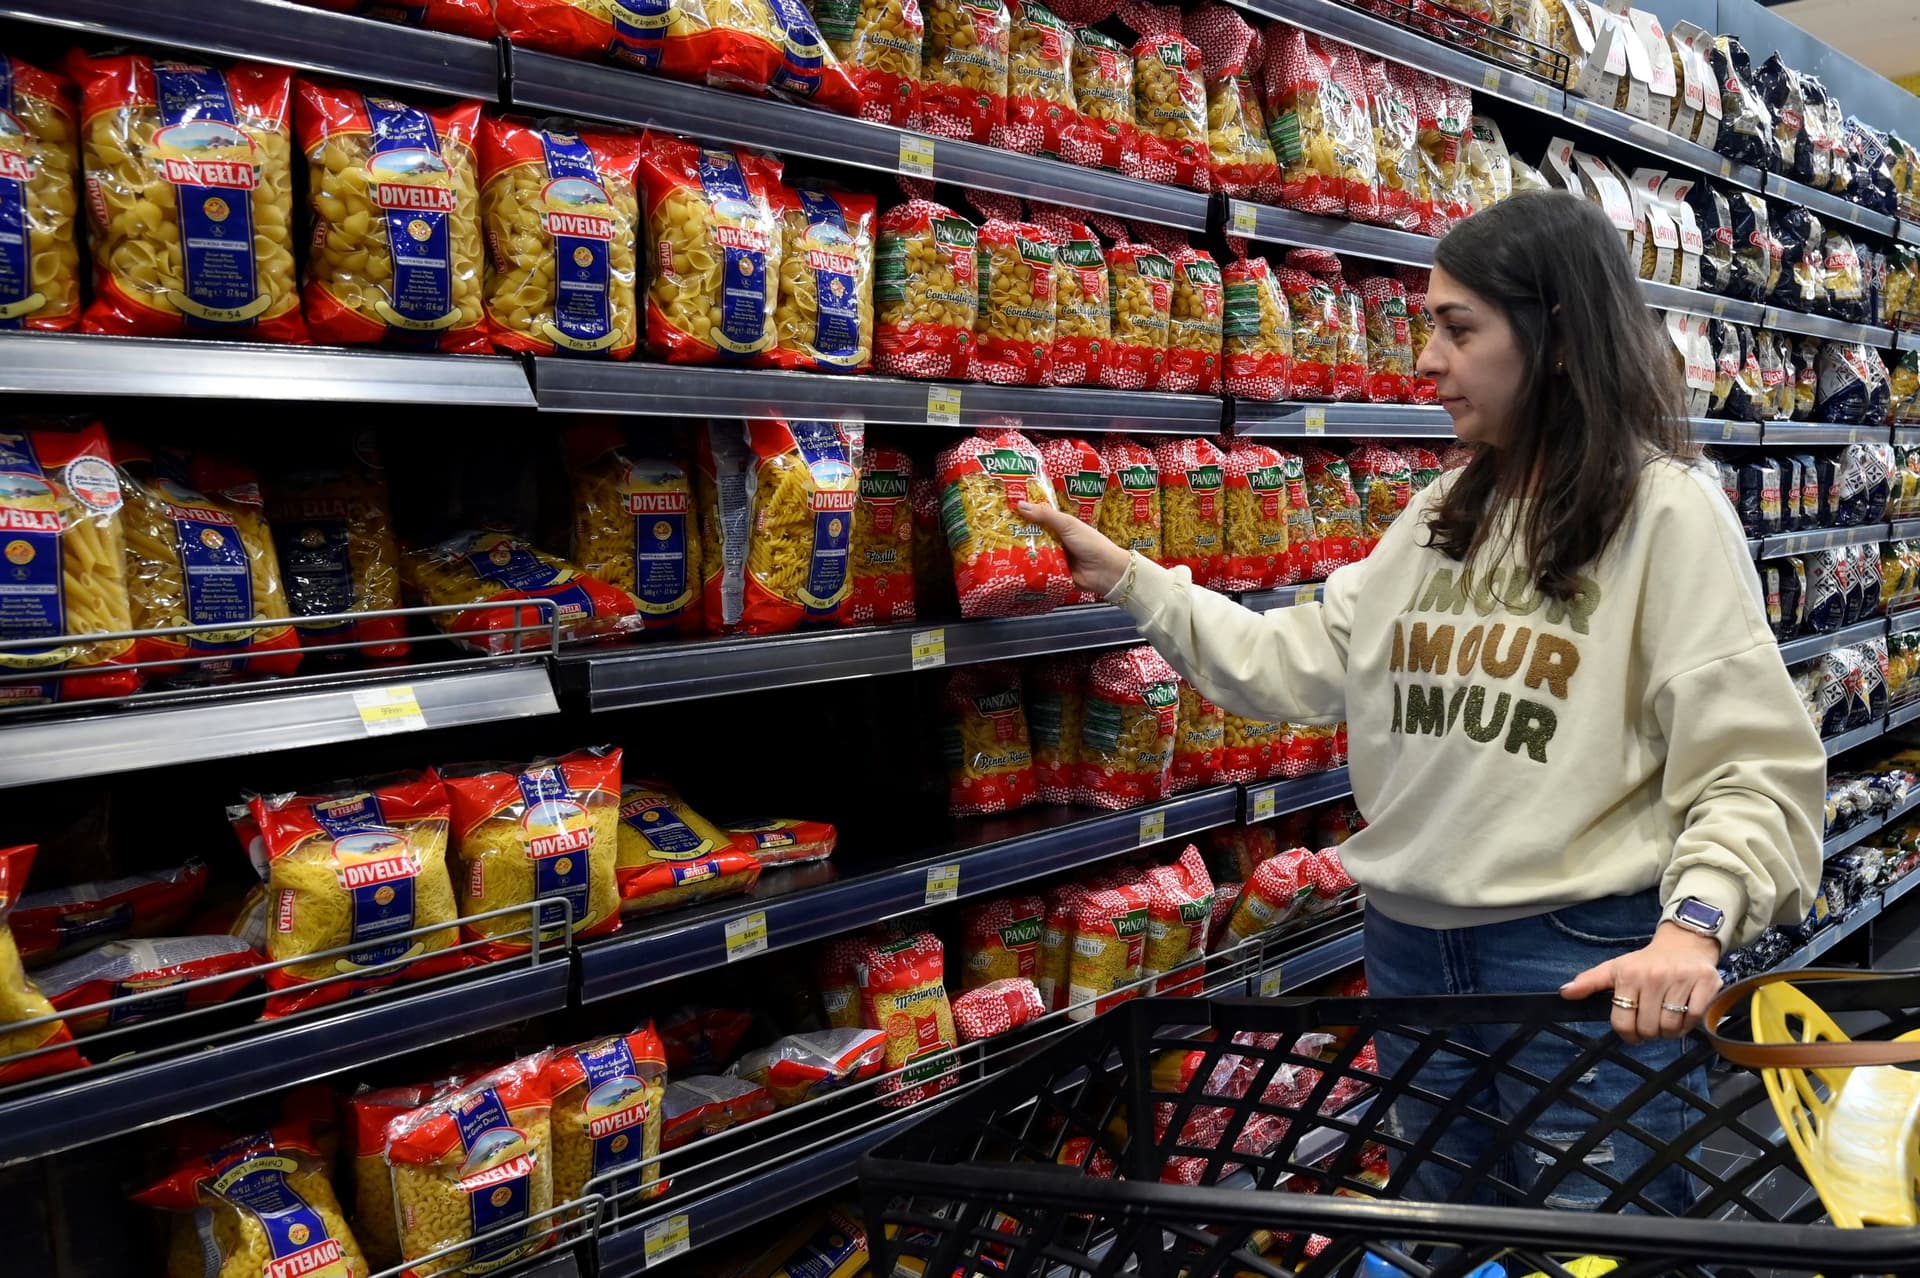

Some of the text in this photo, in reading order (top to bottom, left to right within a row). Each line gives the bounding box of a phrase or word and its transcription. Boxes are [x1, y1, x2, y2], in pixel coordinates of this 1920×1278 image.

[661, 15, 671, 25] 93
[169, 161, 251, 188] DIVELLA
[381, 185, 449, 209] DIVELLA
[552, 213, 610, 239] DIVELLA
[811, 253, 856, 275] DIVELLA
[987, 455, 1035, 472] PANZANI
[861, 479, 906, 494] PANZANI
[633, 495, 686, 511] DIVELLA
[816, 493, 853, 508] DIVELLA
[1008, 523, 1041, 537] Fusilli
[866, 548, 897, 565] Fusilli
[981, 754, 1007, 769] Penne
[331, 802, 363, 817] DIVELLA
[533, 831, 588, 857] DIVELLA
[347, 860, 413, 885] DIVELLA
[472, 861, 482, 896] DIVELLA
[280, 889, 293, 930] DIVELLA
[894, 985, 945, 1010] Vermicelli
[592, 1106, 645, 1136] DIVELLA
[466, 1158, 531, 1188] DIVELLA
[272, 1243, 337, 1278] DIVELLA
